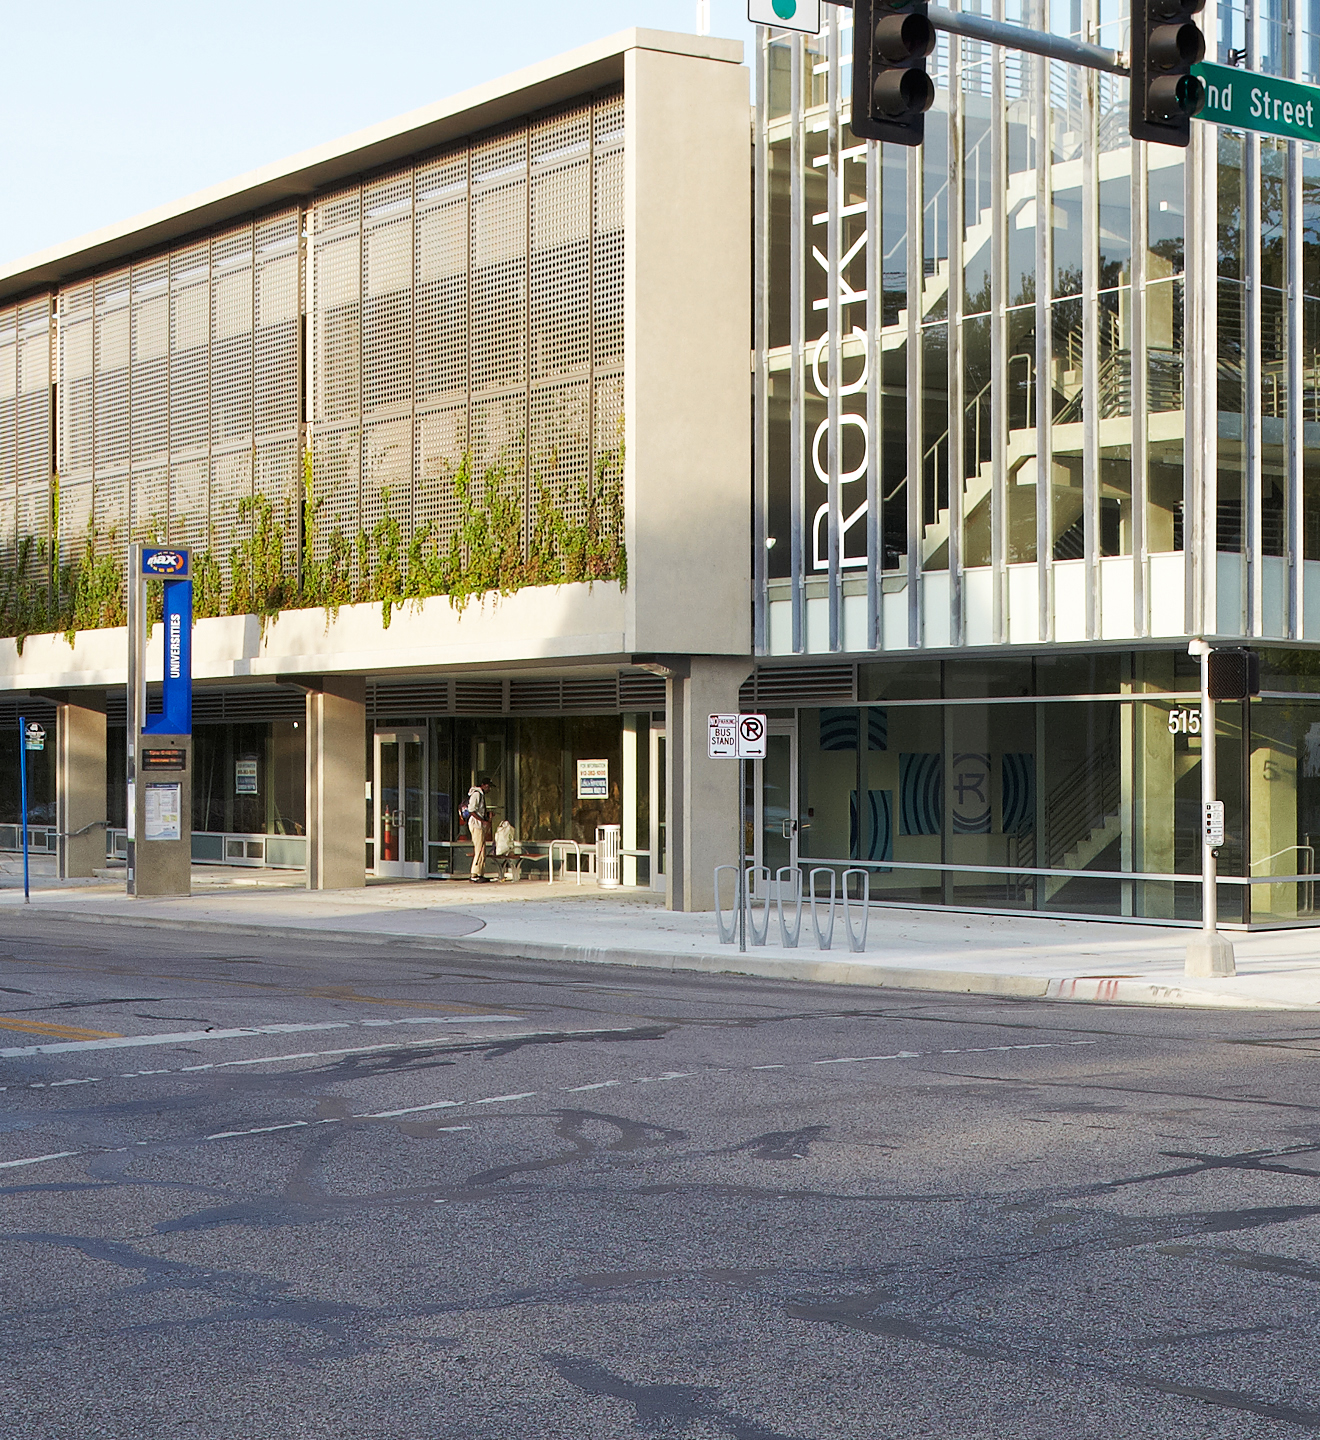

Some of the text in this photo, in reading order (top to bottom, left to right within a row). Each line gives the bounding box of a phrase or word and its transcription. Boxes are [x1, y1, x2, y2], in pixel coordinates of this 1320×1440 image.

[1249, 87, 1314, 129] Street
[170, 613, 181, 679] UNIVERSITIES
[715, 728, 731, 737] BUS
[1168, 709, 1203, 735] 515
[711, 736, 735, 746] STAND
